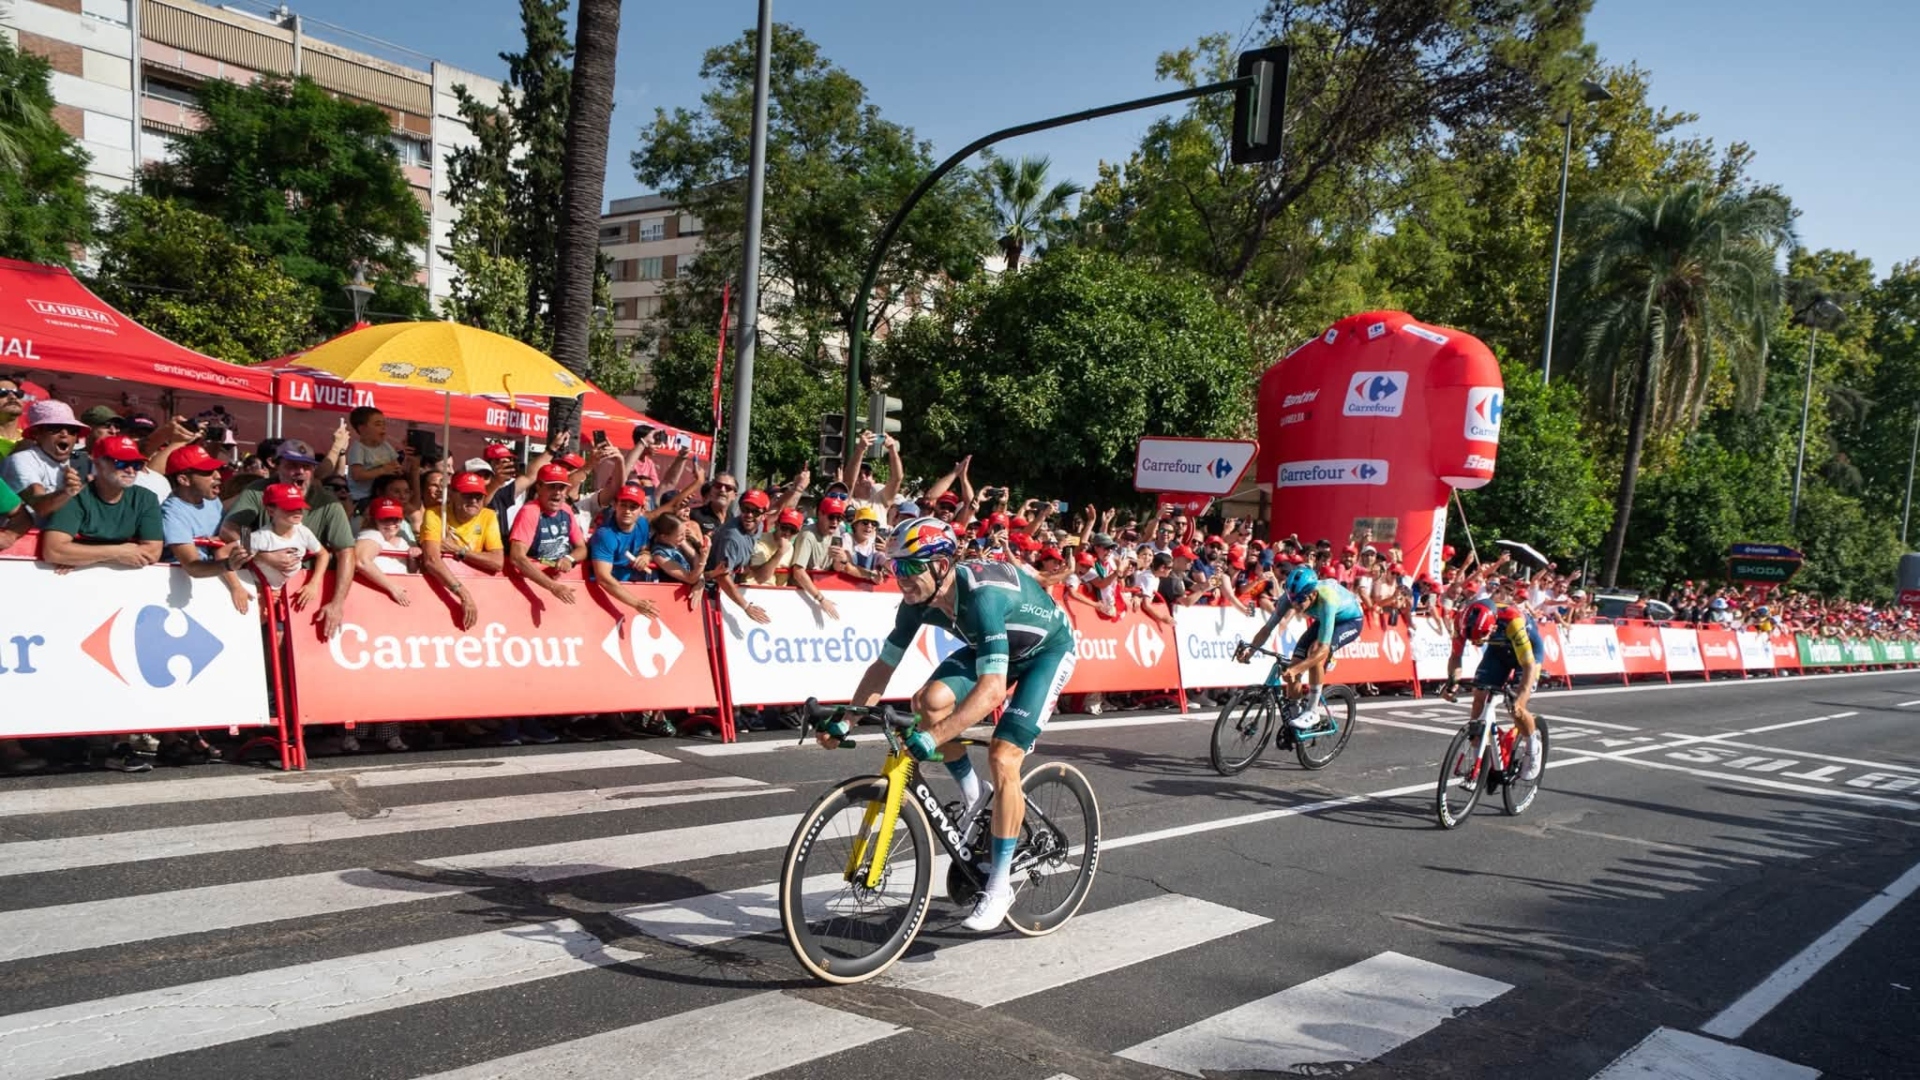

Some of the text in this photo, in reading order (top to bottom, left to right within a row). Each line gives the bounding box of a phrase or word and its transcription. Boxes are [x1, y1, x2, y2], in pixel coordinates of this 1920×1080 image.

[38, 303, 110, 324] LA VUELTA
[153, 363, 249, 386] santinicycling.com
[290, 381, 376, 408] LA VUELTA
[486, 407, 532, 431] OFFICIAL
[1348, 403, 1396, 413] Carrefour
[1142, 457, 1202, 474] Carrefour
[1280, 465, 1345, 482] Carrefour
[329, 622, 583, 670] Carrefour
[747, 626, 887, 664] Carrefou
